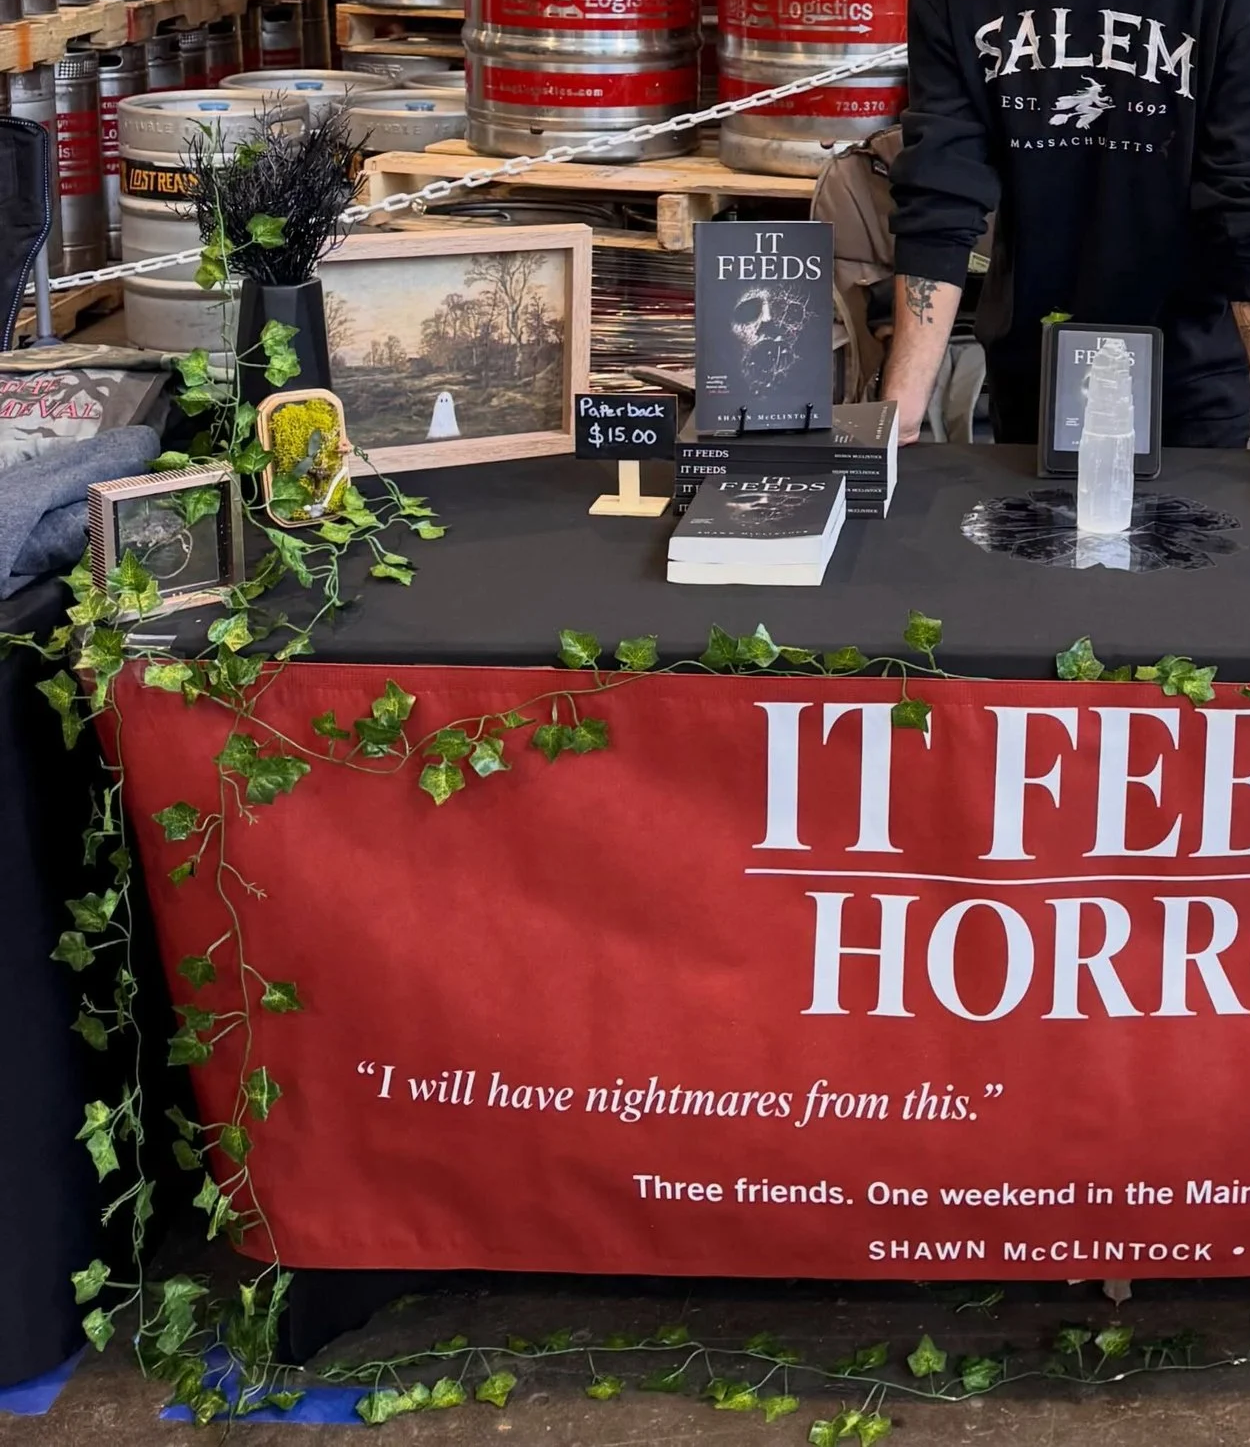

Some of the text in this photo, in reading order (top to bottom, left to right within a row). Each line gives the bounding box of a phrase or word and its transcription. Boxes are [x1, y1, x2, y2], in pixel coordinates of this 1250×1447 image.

[973, 7, 1197, 101] SALEM
[1001, 94, 1168, 117] EST. 1692
[1010, 136, 1154, 153] MASSACHUETTS
[129, 167, 157, 191] LOST
[754, 232, 784, 254] IT
[716, 255, 822, 281] FEEDS
[757, 413, 819, 421] McCLINTOK
[587, 422, 657, 449] $15.00
[682, 448, 694, 458] IT
[695, 449, 730, 459] FEEDS
[680, 464, 692, 474] IT
[693, 464, 728, 474] FEEDS
[760, 475, 791, 484] IT
[682, 484, 694, 494] IT
[718, 481, 826, 493] FEEDS
[751, 701, 931, 854] IT
[407, 1067, 475, 1108] will
[488, 1071, 574, 1113] have
[585, 1075, 793, 1125] nightmares
[794, 1079, 891, 1129] from
[901, 1082, 1005, 1123] this.”
[633, 1174, 725, 1205] Three
[734, 1176, 856, 1207] friends.
[867, 1180, 930, 1209] One
[938, 1181, 1077, 1208] weekend
[1086, 1181, 1114, 1206] in
[1125, 1181, 1176, 1206] the
[867, 1239, 988, 1262] SHAWN
[1003, 1239, 1214, 1263] McCLINTOCK
